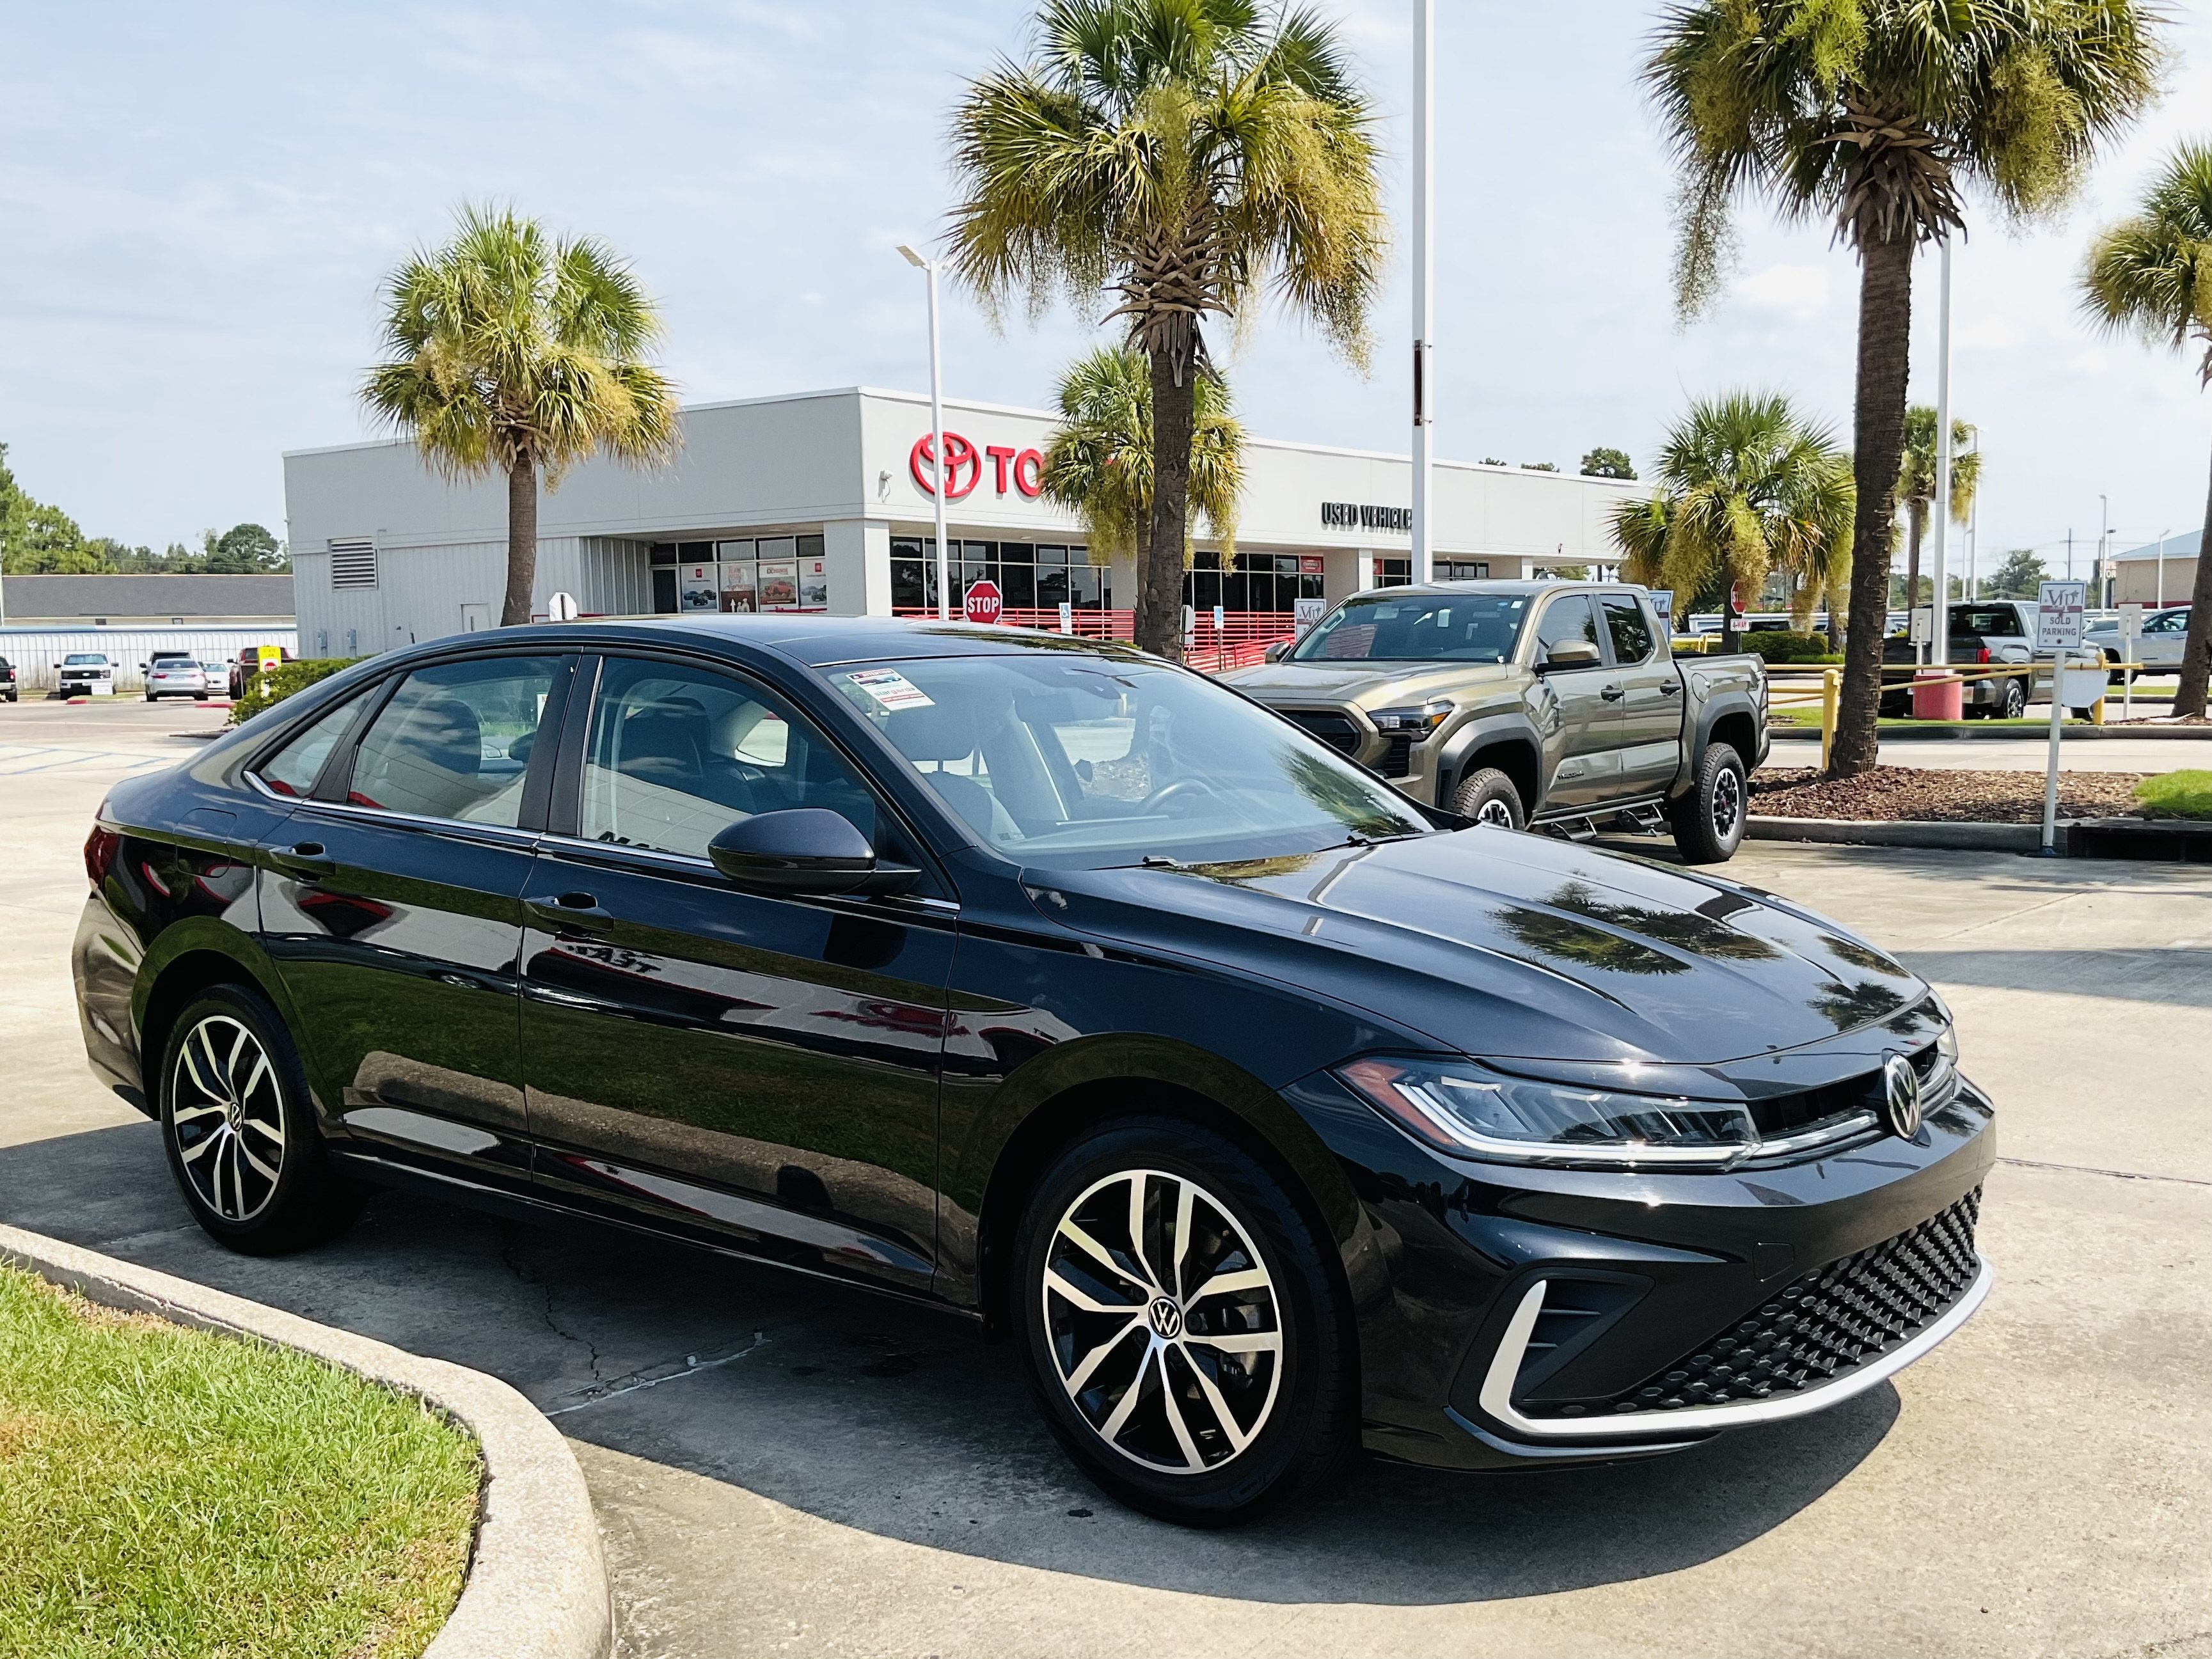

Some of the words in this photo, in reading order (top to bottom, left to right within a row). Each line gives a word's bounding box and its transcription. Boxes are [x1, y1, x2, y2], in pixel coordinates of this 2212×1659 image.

[1321, 501, 1359, 526] USED
[1360, 505, 1412, 530] VEHICLE
[967, 596, 1000, 613] STOP
[2050, 617, 2071, 625] SOLD
[2042, 627, 2077, 636] PARKING
